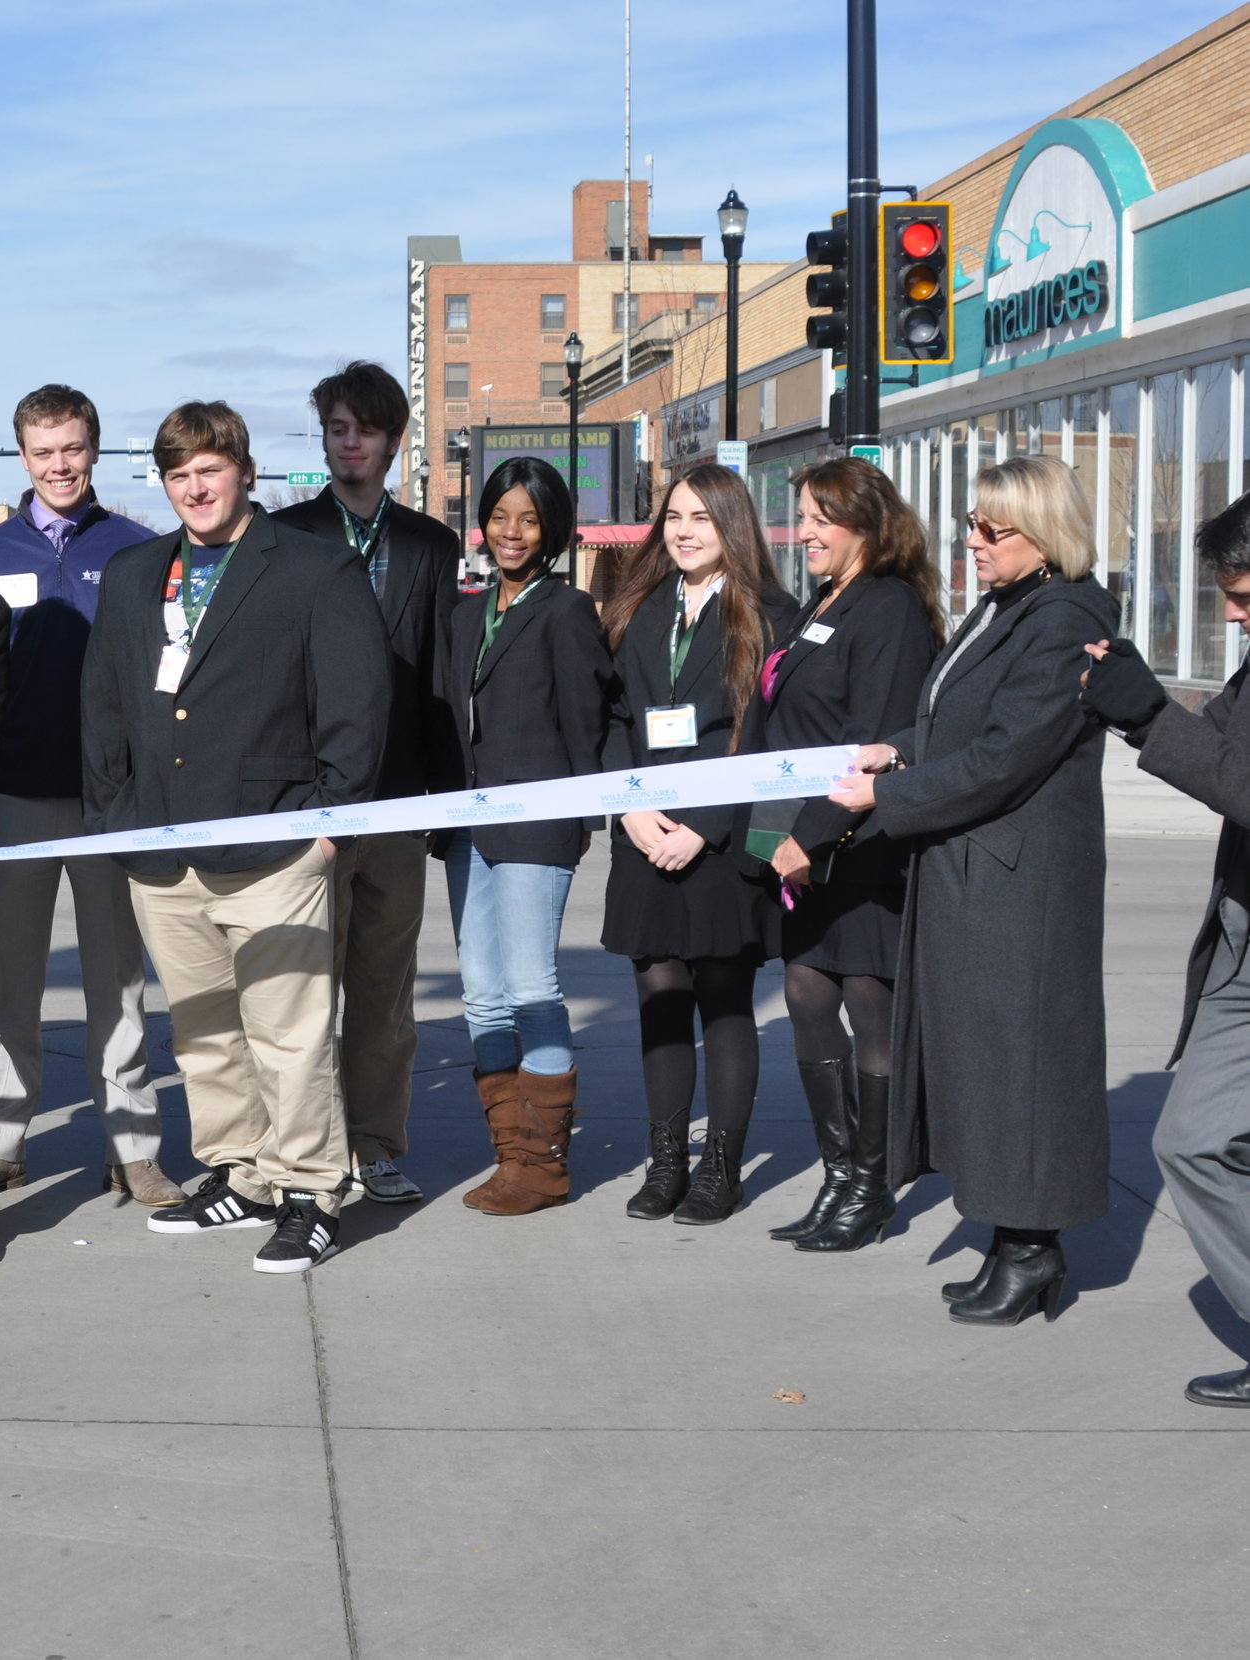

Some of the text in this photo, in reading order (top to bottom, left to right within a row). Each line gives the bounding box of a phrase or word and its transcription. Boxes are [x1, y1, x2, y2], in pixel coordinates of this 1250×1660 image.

[985, 260, 1105, 347] maurices
[410, 258, 426, 471] PLAINSMAN
[485, 433, 546, 448] NORTH
[291, 474, 323, 483] 4th St
[752, 775, 830, 787] WILLISTON AREA
[600, 792, 650, 800] WILLISTON
[446, 805, 496, 814] WILLISTON
[289, 819, 341, 828] WILLISTON
